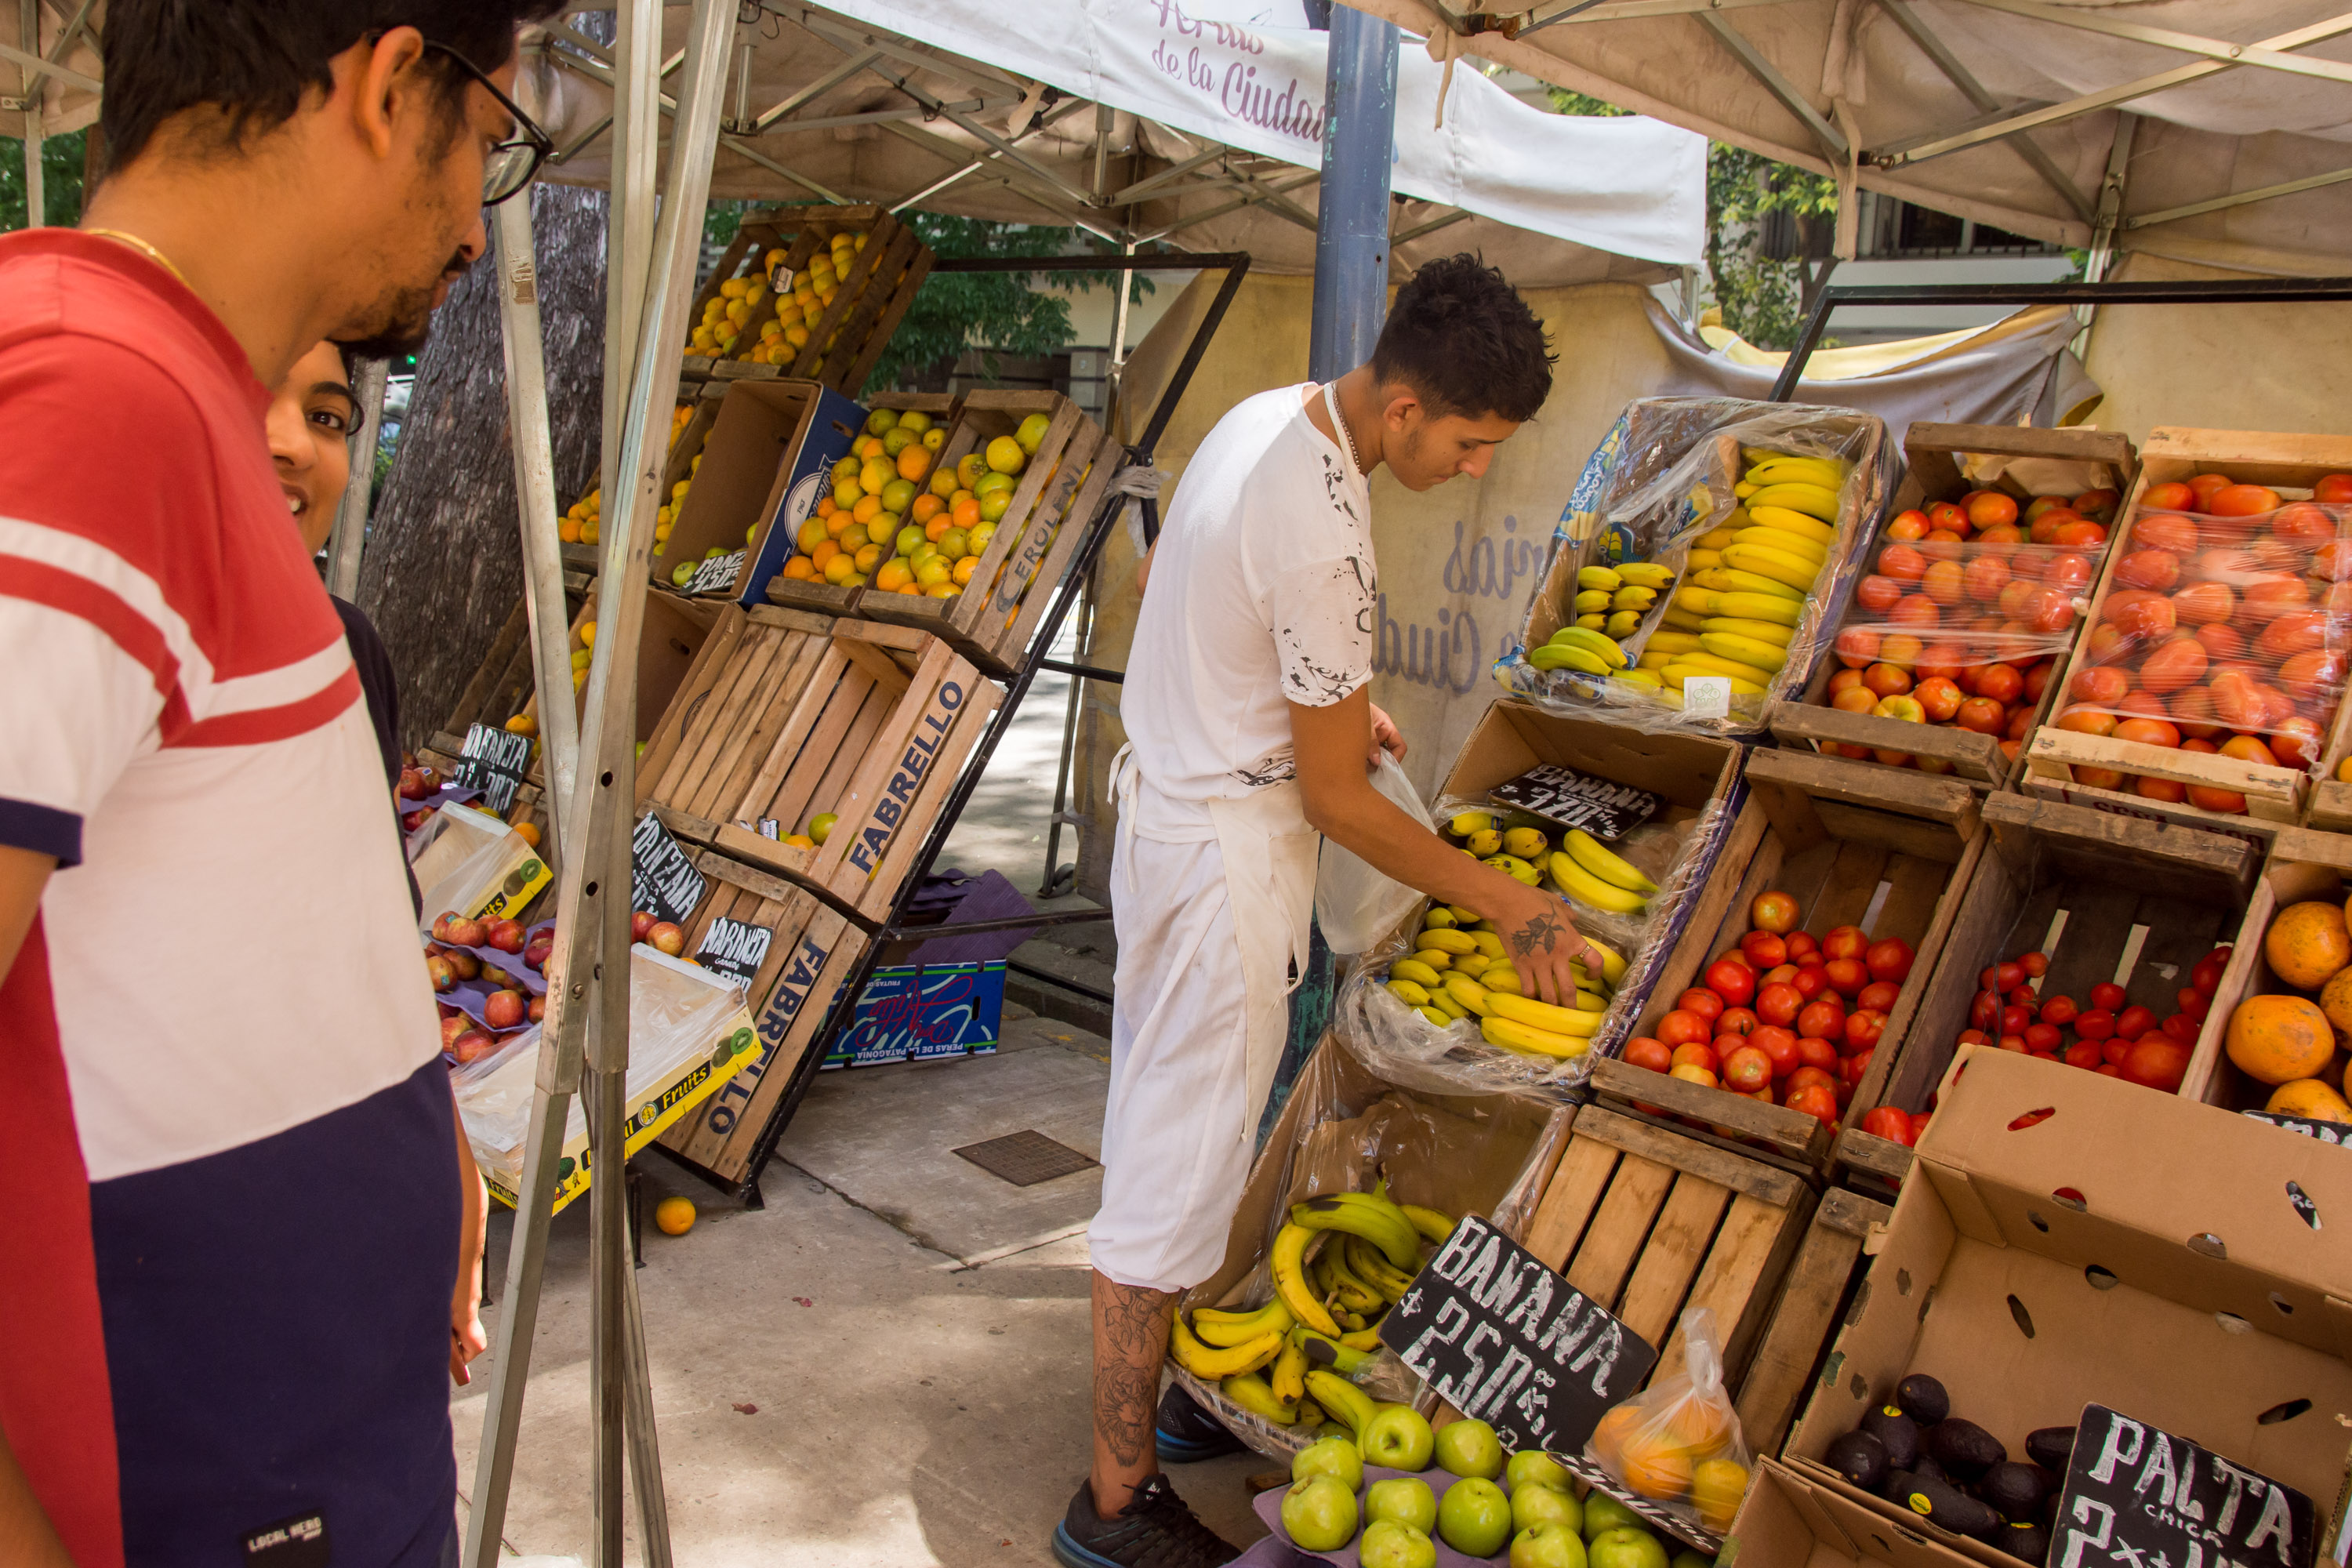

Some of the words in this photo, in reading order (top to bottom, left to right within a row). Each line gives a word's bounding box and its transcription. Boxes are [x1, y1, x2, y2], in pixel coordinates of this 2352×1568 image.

[1152, 38, 1182, 80] de
[1188, 46, 1215, 92] la
[1221, 62, 1325, 143] Ciuda
[461, 724, 528, 774] NARANJA
[849, 681, 963, 876] FABRELLO
[1523, 763, 1657, 816] BANANA
[633, 811, 703, 923] MANZANA
[696, 916, 771, 969] NARANJA
[857, 1048, 906, 1059] PATAGONIA
[922, 1045, 933, 1054] DE
[935, 1043, 963, 1052] PERAS
[662, 1067, 706, 1109] Fruits
[1432, 1216, 1623, 1399] BANANA
[2088, 1413, 2292, 1566] PALTA
[248, 1529, 289, 1553] LOCAL
